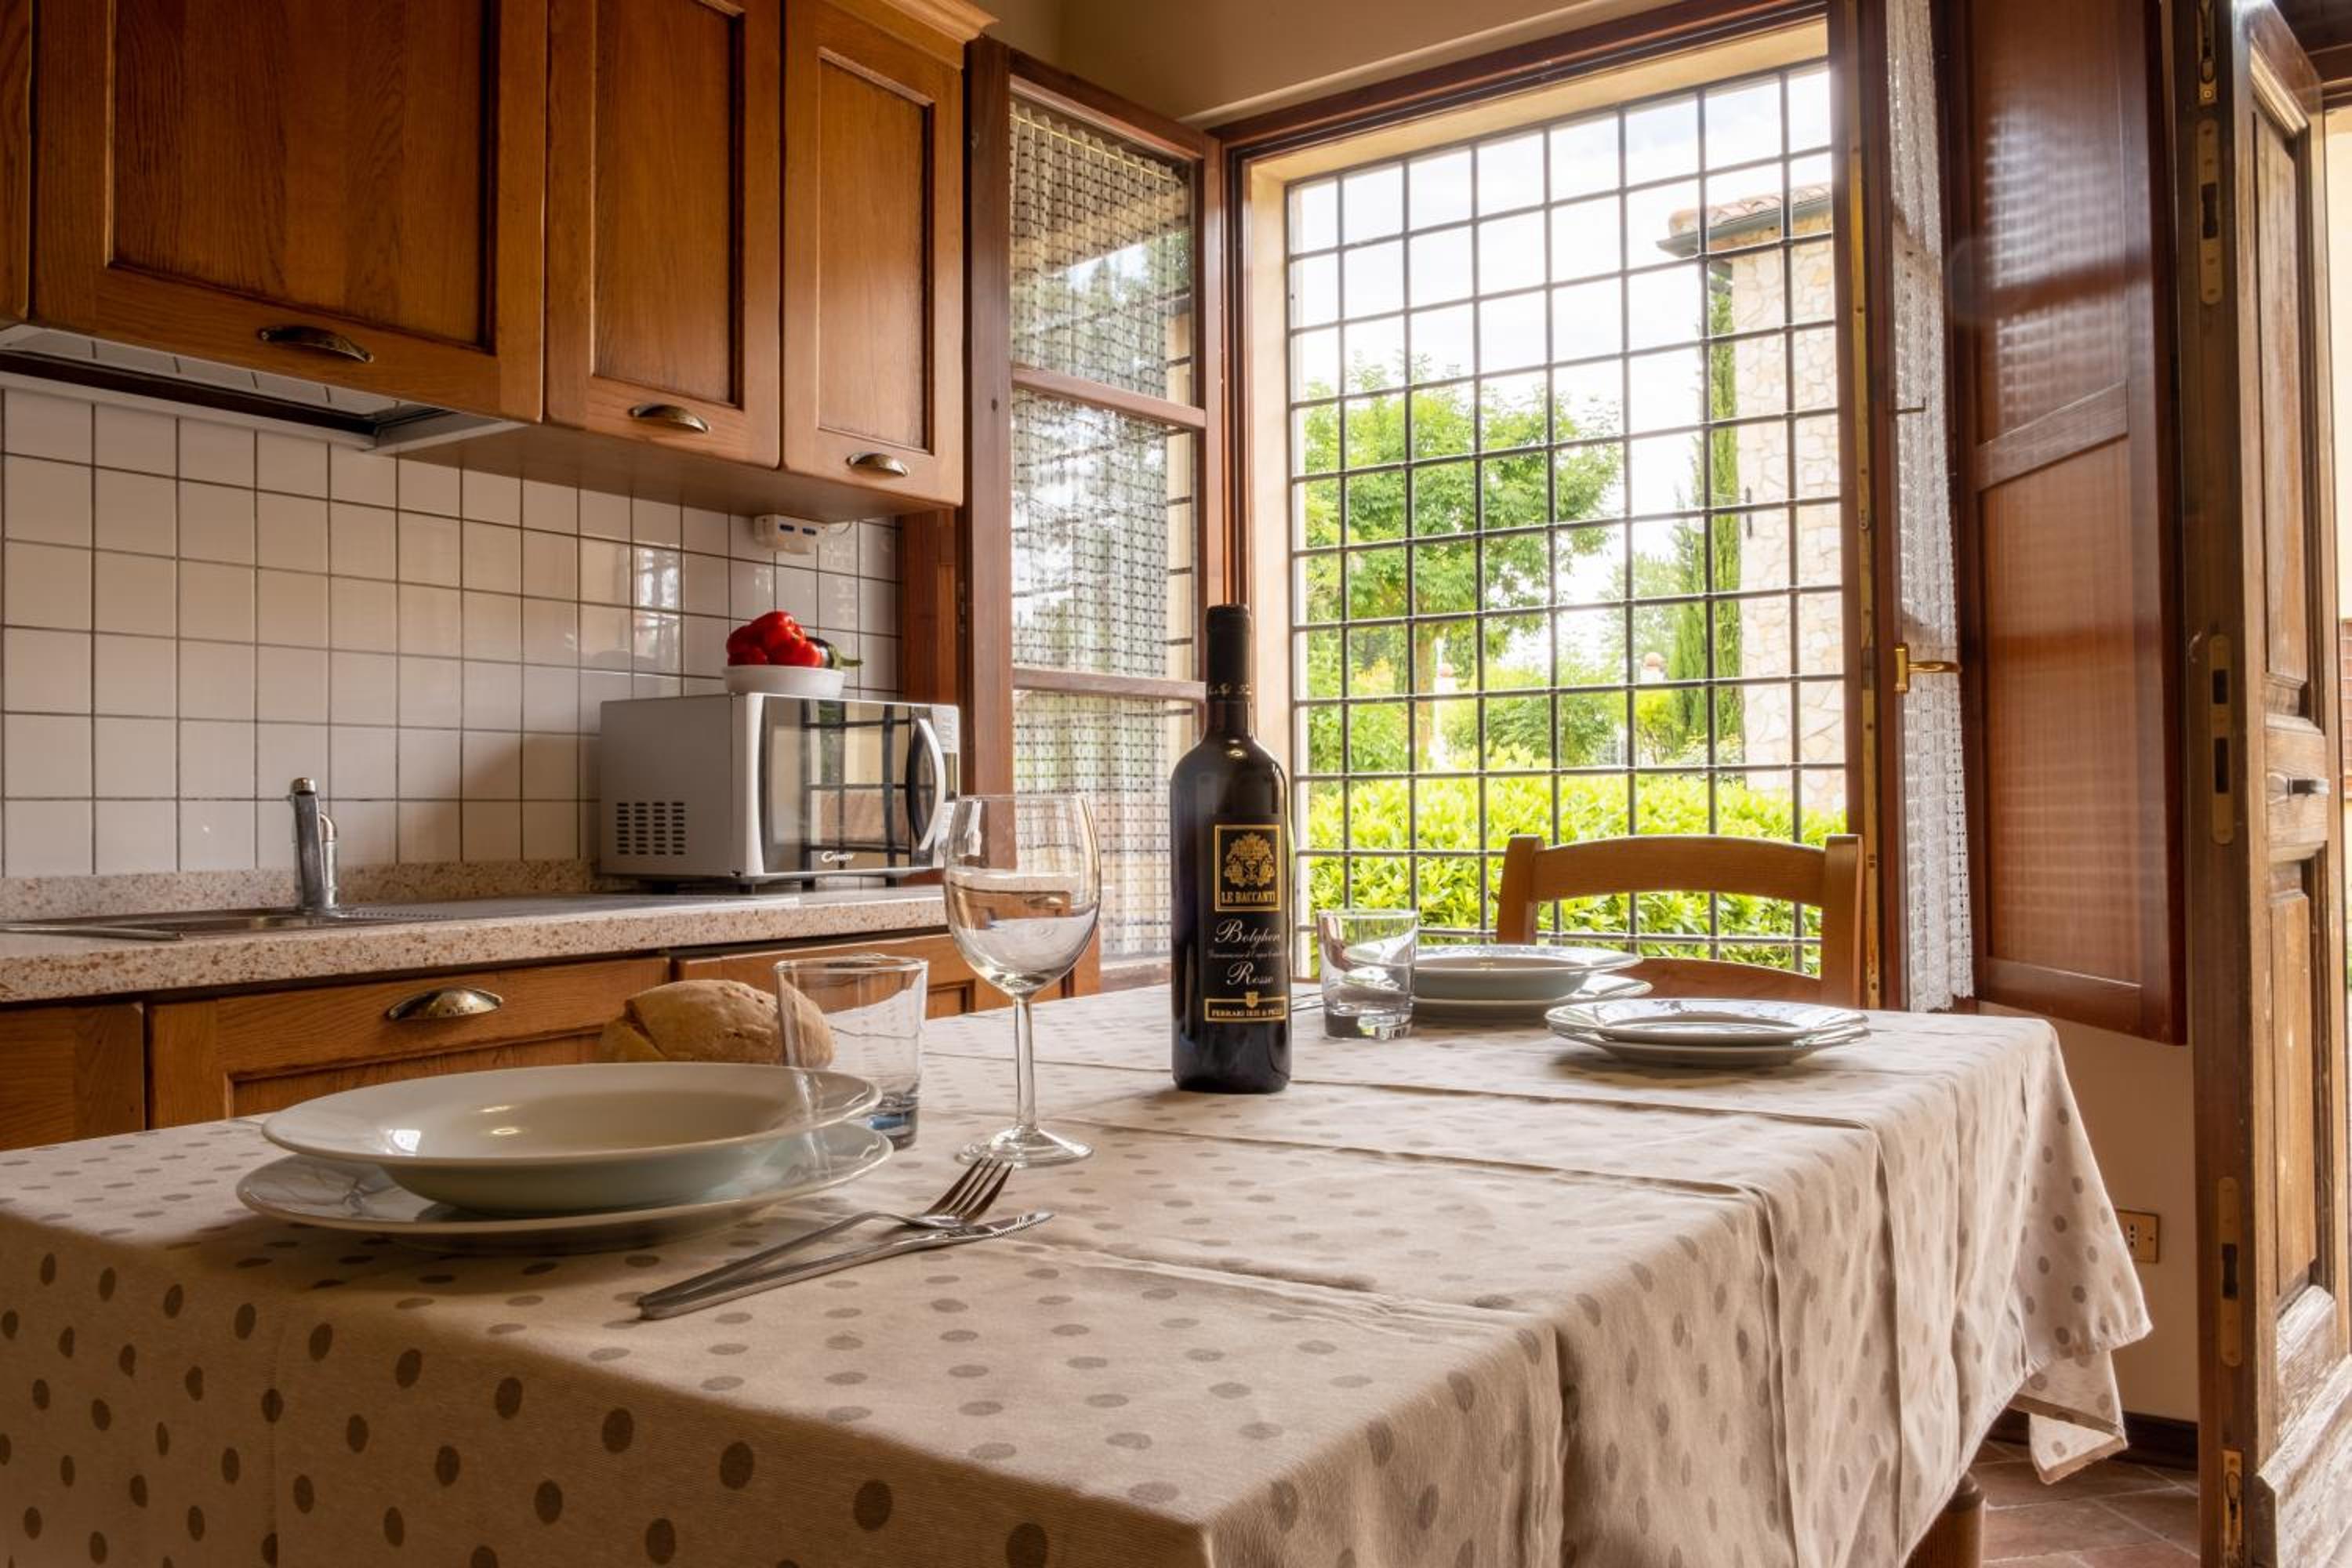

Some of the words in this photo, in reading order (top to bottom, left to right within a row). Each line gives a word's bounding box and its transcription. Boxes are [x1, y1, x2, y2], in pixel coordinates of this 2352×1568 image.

[821, 851, 855, 862] CANDY
[1221, 891, 1233, 903] LE
[1236, 891, 1276, 903] BACCANTI
[1225, 961, 1274, 985] Rosso
